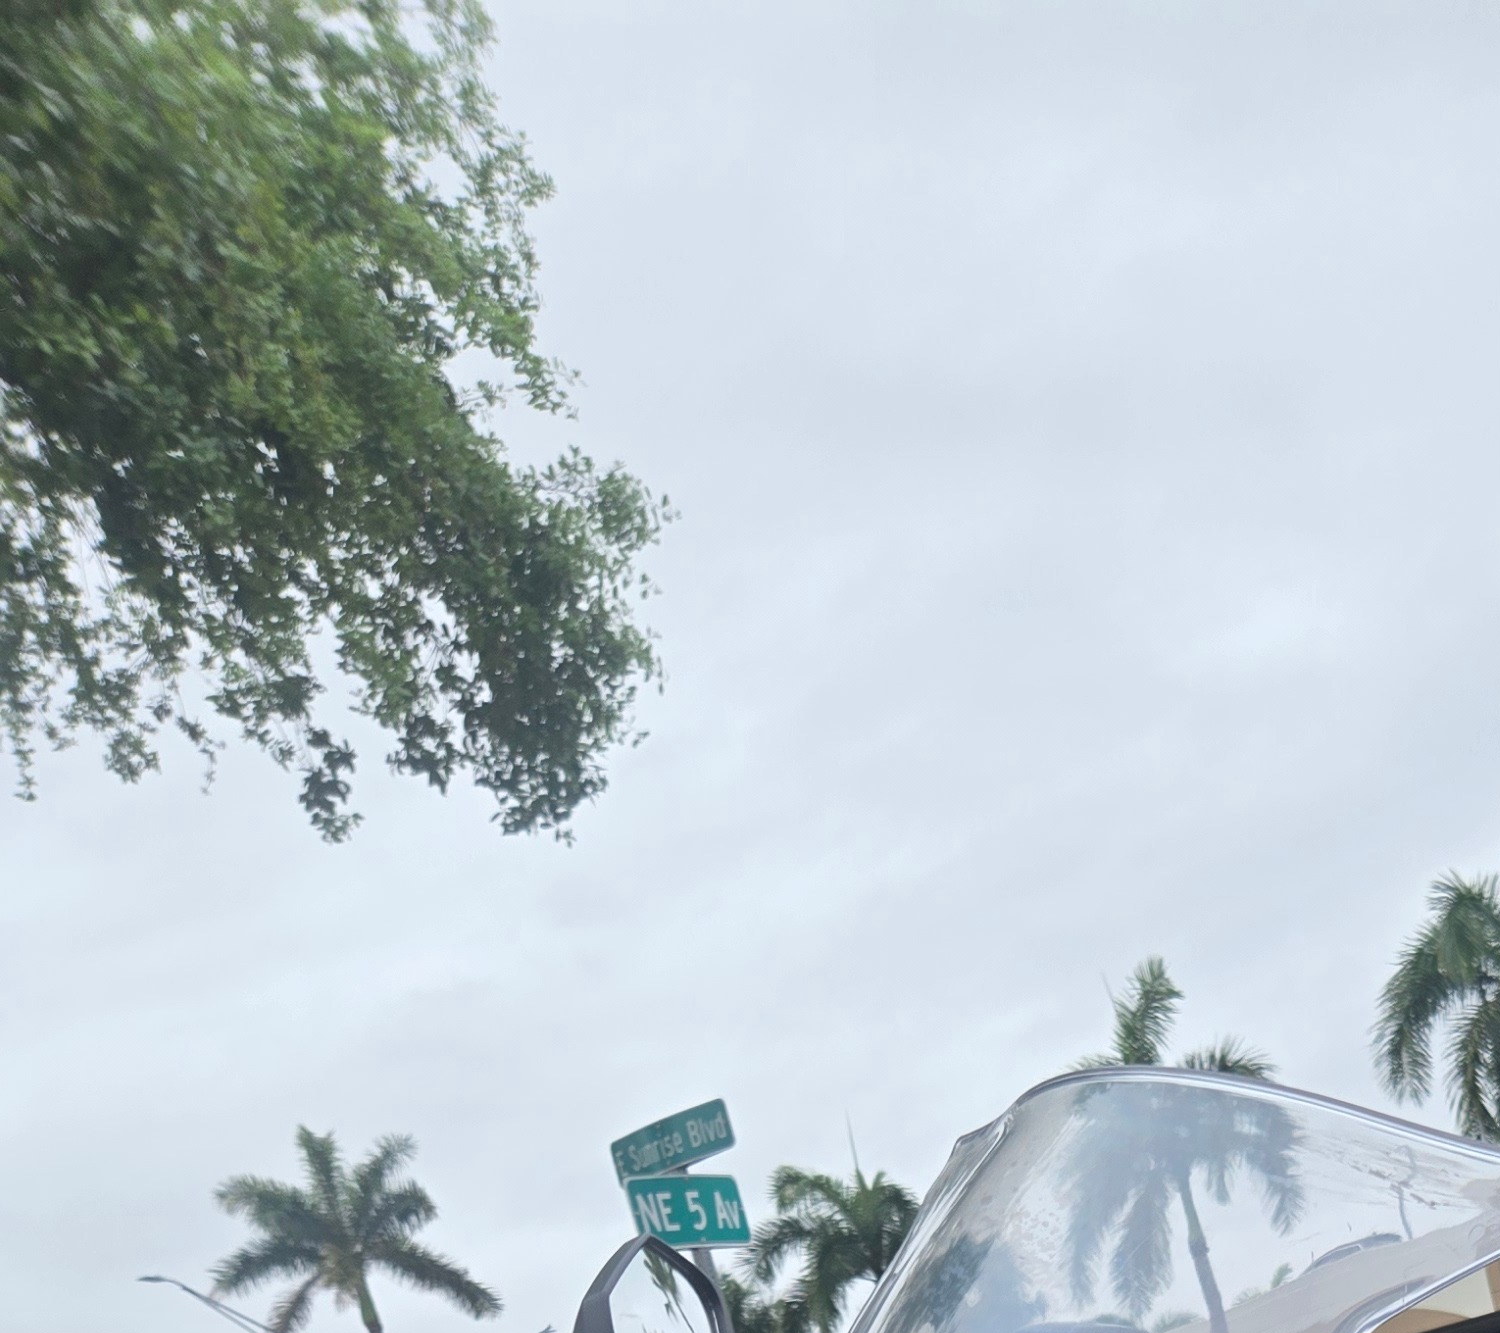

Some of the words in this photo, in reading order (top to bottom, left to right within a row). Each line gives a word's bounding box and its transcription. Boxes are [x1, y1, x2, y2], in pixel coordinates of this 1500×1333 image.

[629, 1131, 684, 1171] Sunrise
[687, 1113, 726, 1147] Blvd
[635, 1191, 681, 1233] NE
[685, 1190, 707, 1231] 5
[714, 1190, 741, 1230] Av
